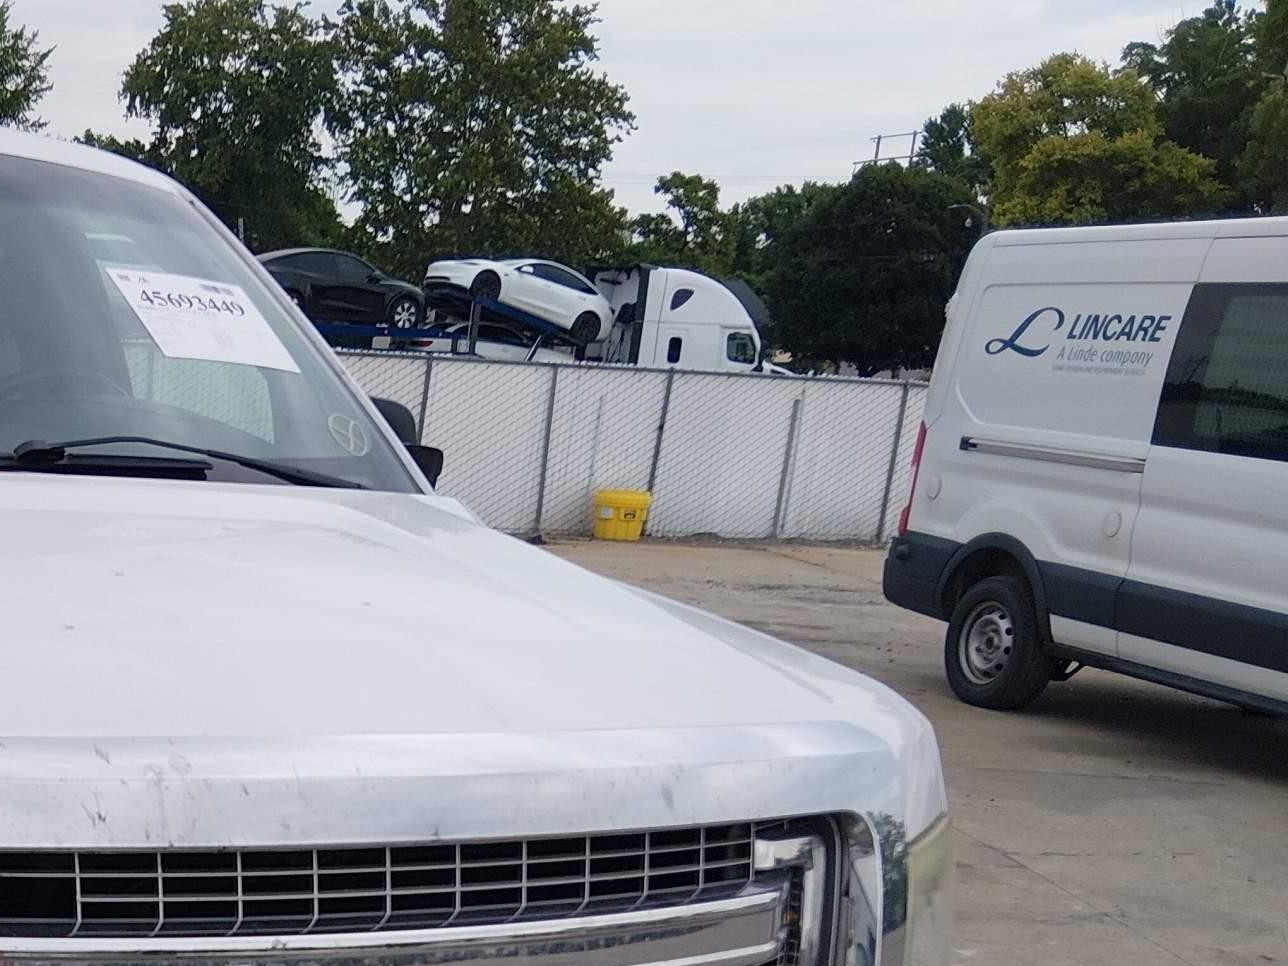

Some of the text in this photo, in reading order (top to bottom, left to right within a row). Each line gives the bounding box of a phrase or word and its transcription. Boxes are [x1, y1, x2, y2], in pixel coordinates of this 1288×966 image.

[140, 289, 246, 317] 45693449
[1066, 314, 1172, 343] LINCARE
[1056, 345, 1154, 368] A Linde company
